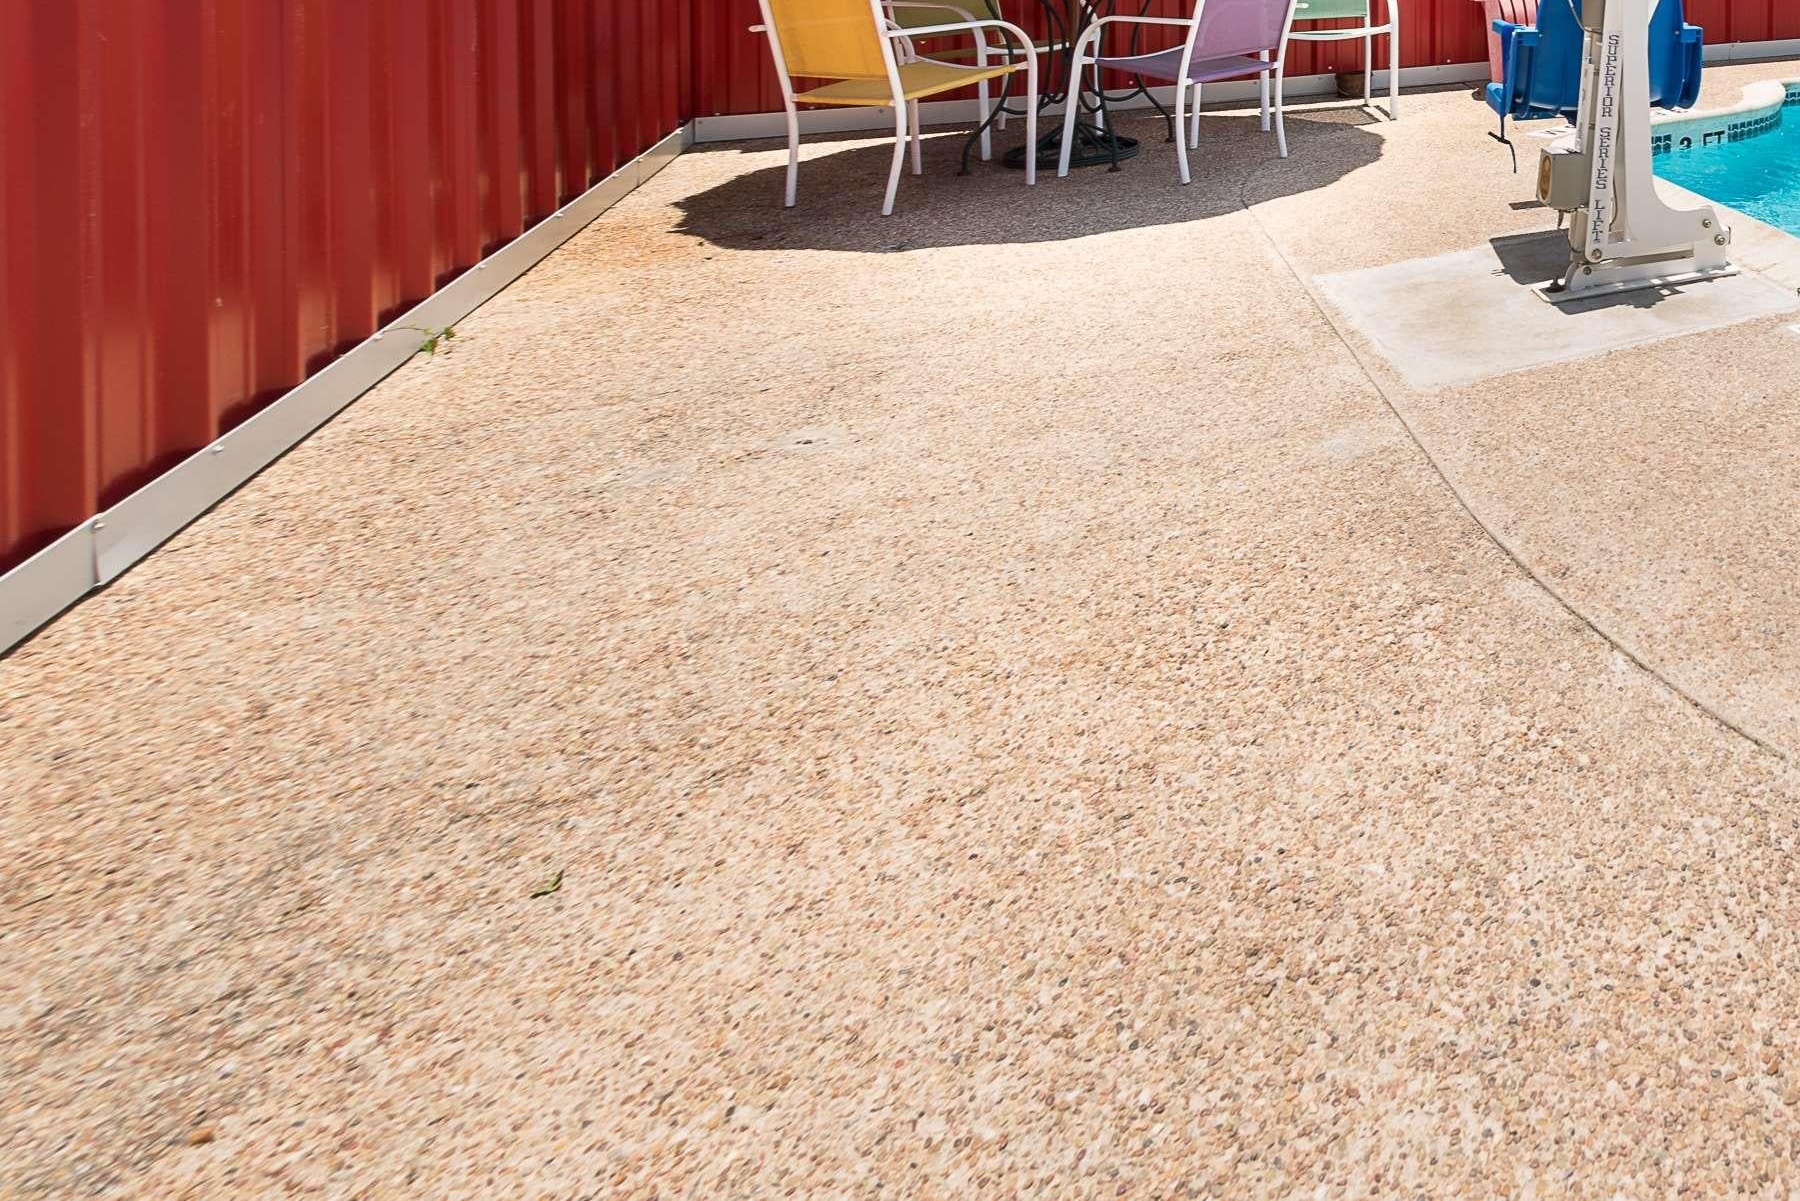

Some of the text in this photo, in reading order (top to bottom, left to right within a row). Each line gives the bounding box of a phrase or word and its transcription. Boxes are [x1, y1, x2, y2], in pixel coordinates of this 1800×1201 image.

[1591, 34, 1620, 244] SUPERIOR SERIES LIFT
[1702, 129, 1726, 147] FT
